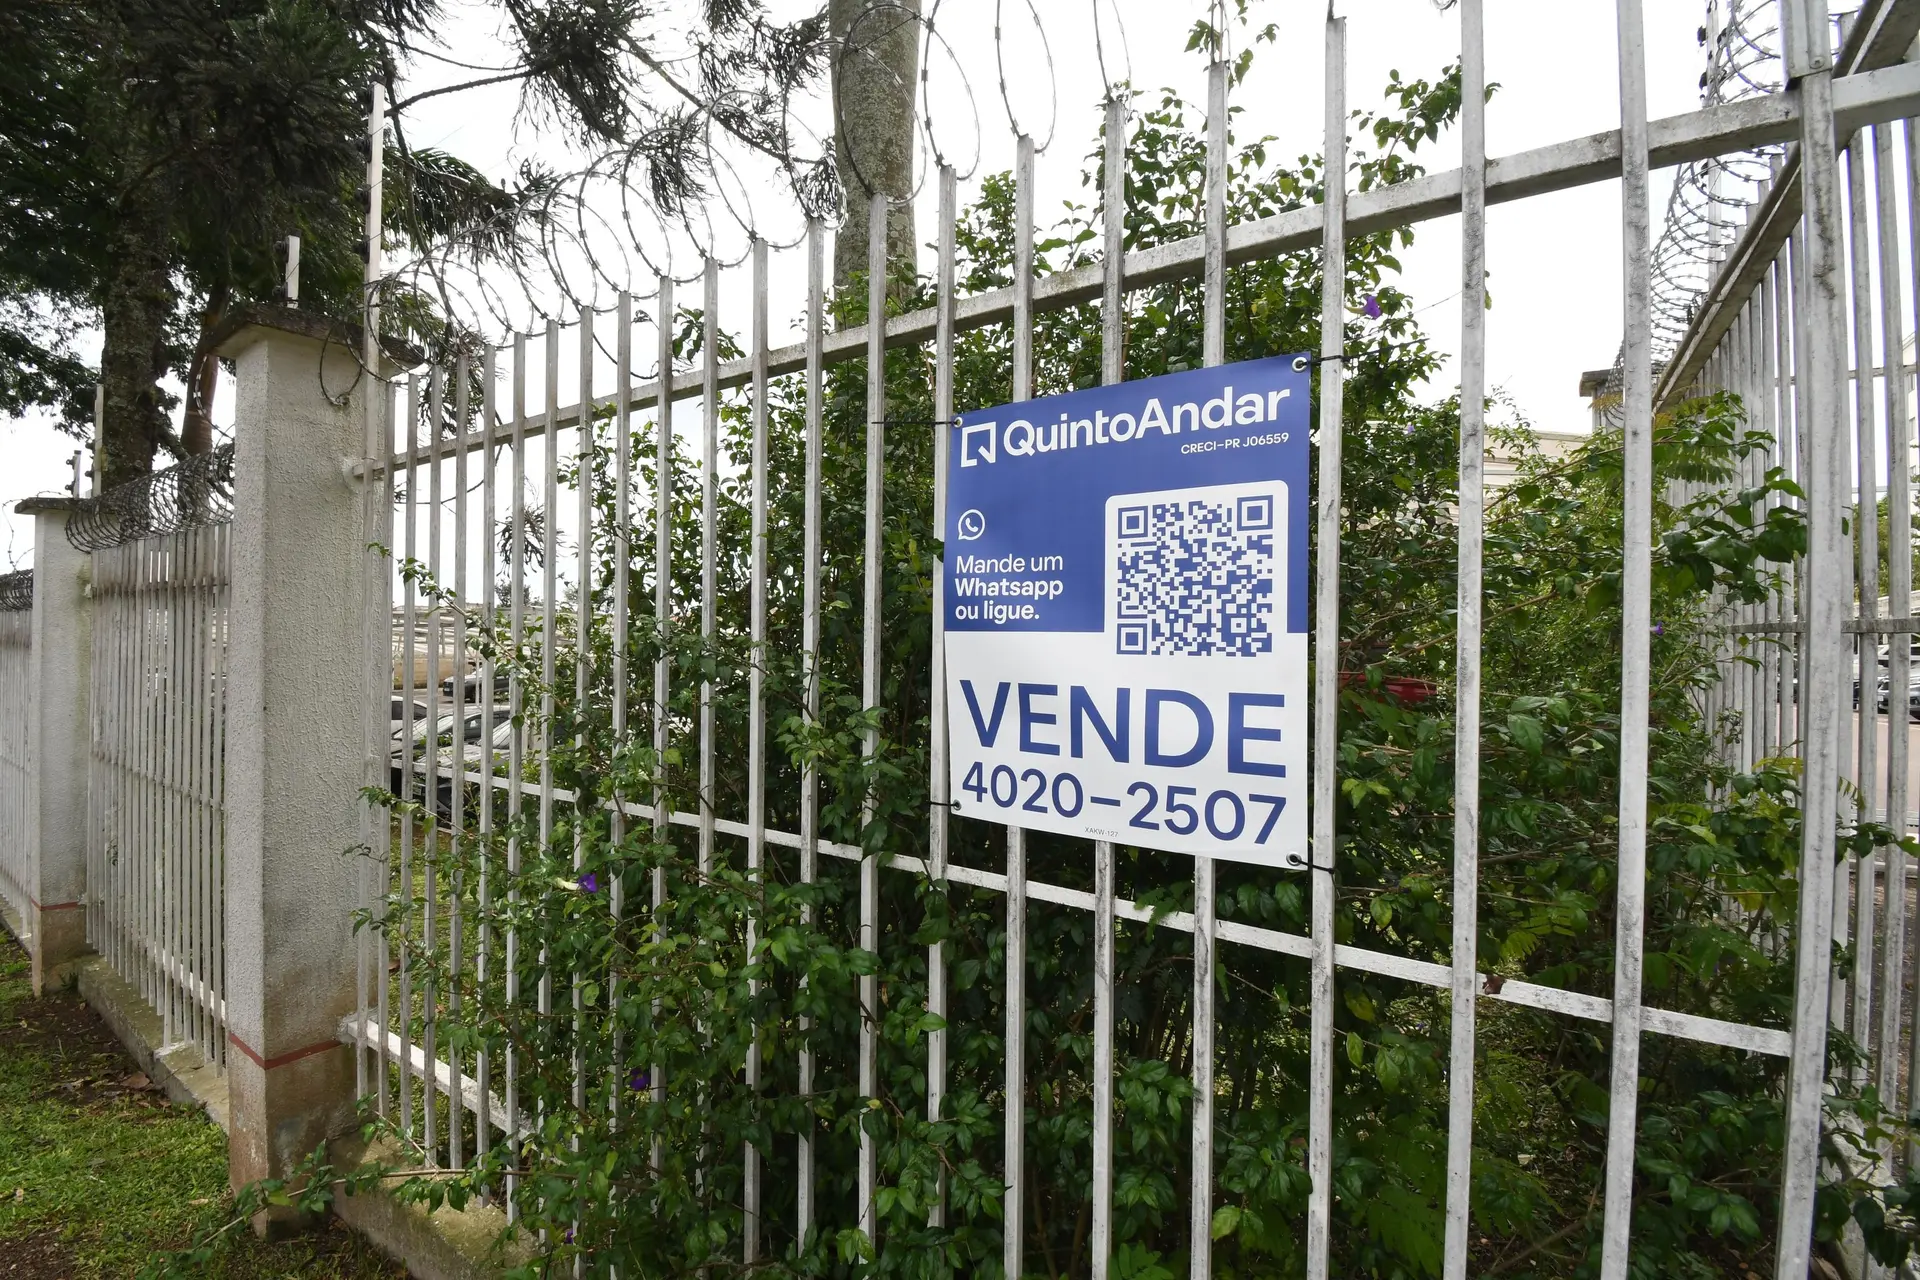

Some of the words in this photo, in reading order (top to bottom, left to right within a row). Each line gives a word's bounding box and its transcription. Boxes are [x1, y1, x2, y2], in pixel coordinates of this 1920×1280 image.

[1003, 386, 1290, 457] QuintoAndar
[1181, 439, 1241, 454] CRECI-PR
[1242, 432, 1289, 447] J06559
[956, 553, 1026, 574] Mande
[1030, 555, 1063, 572] um
[954, 577, 1064, 600] Whatsapp
[955, 605, 979, 620] ou
[983, 600, 1040, 625] ligue.
[959, 679, 1287, 778] VENDE
[962, 761, 1287, 845] 4020-2507
